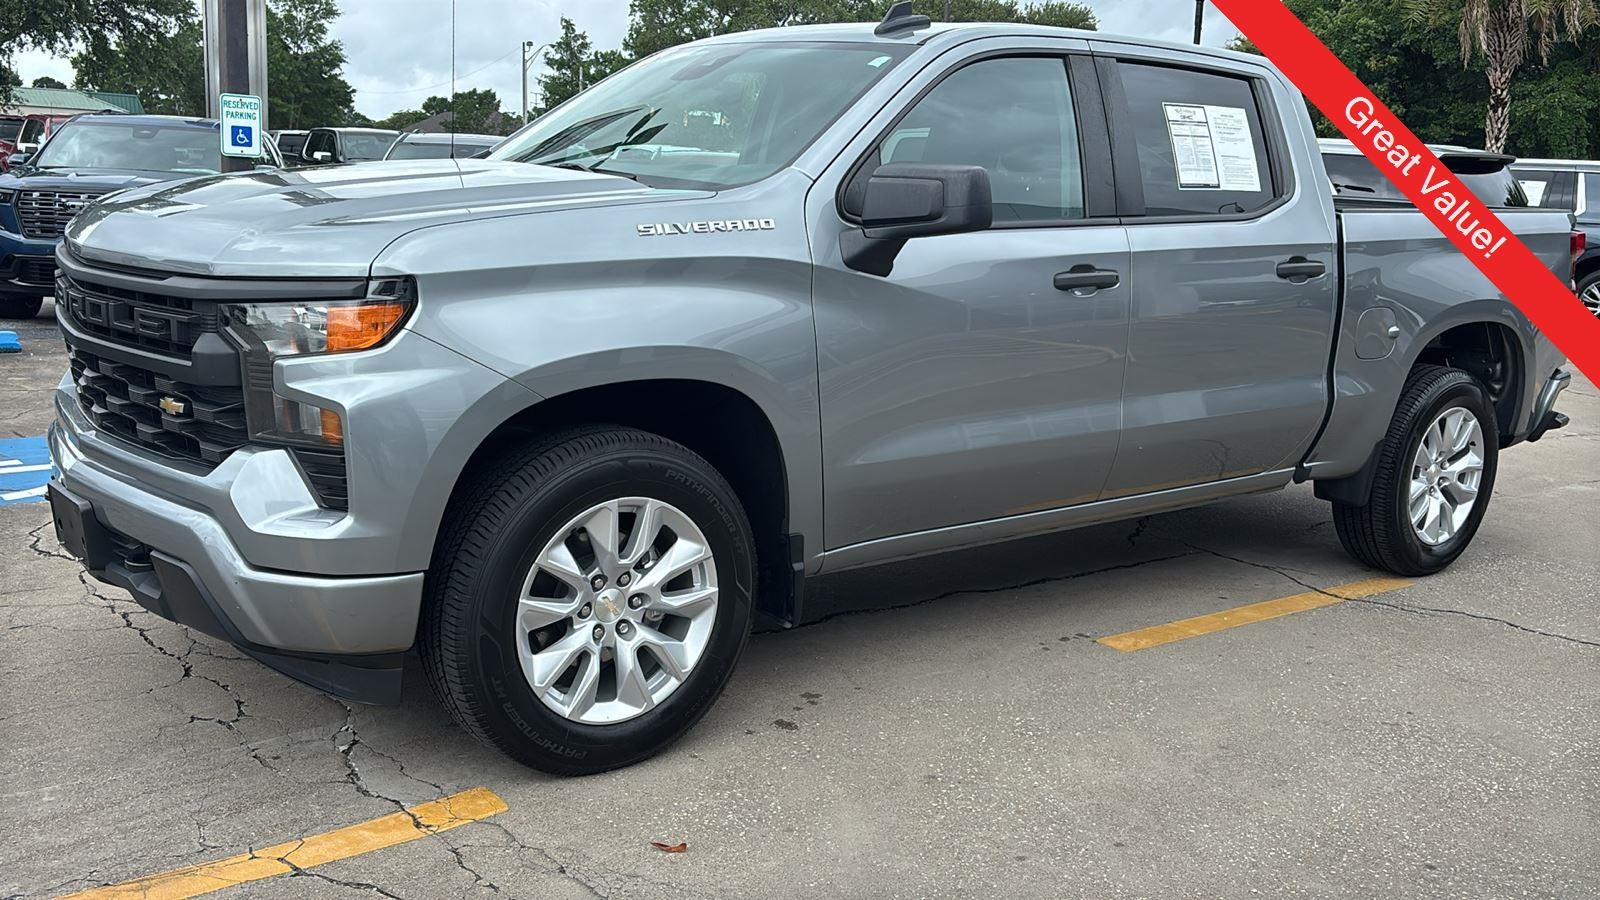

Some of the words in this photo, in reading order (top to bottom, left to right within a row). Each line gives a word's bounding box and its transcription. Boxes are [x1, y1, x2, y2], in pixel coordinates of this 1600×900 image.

[223, 99, 259, 111] RESERVED
[225, 110, 257, 121] PARKING
[637, 218, 776, 236] SILVERADO
